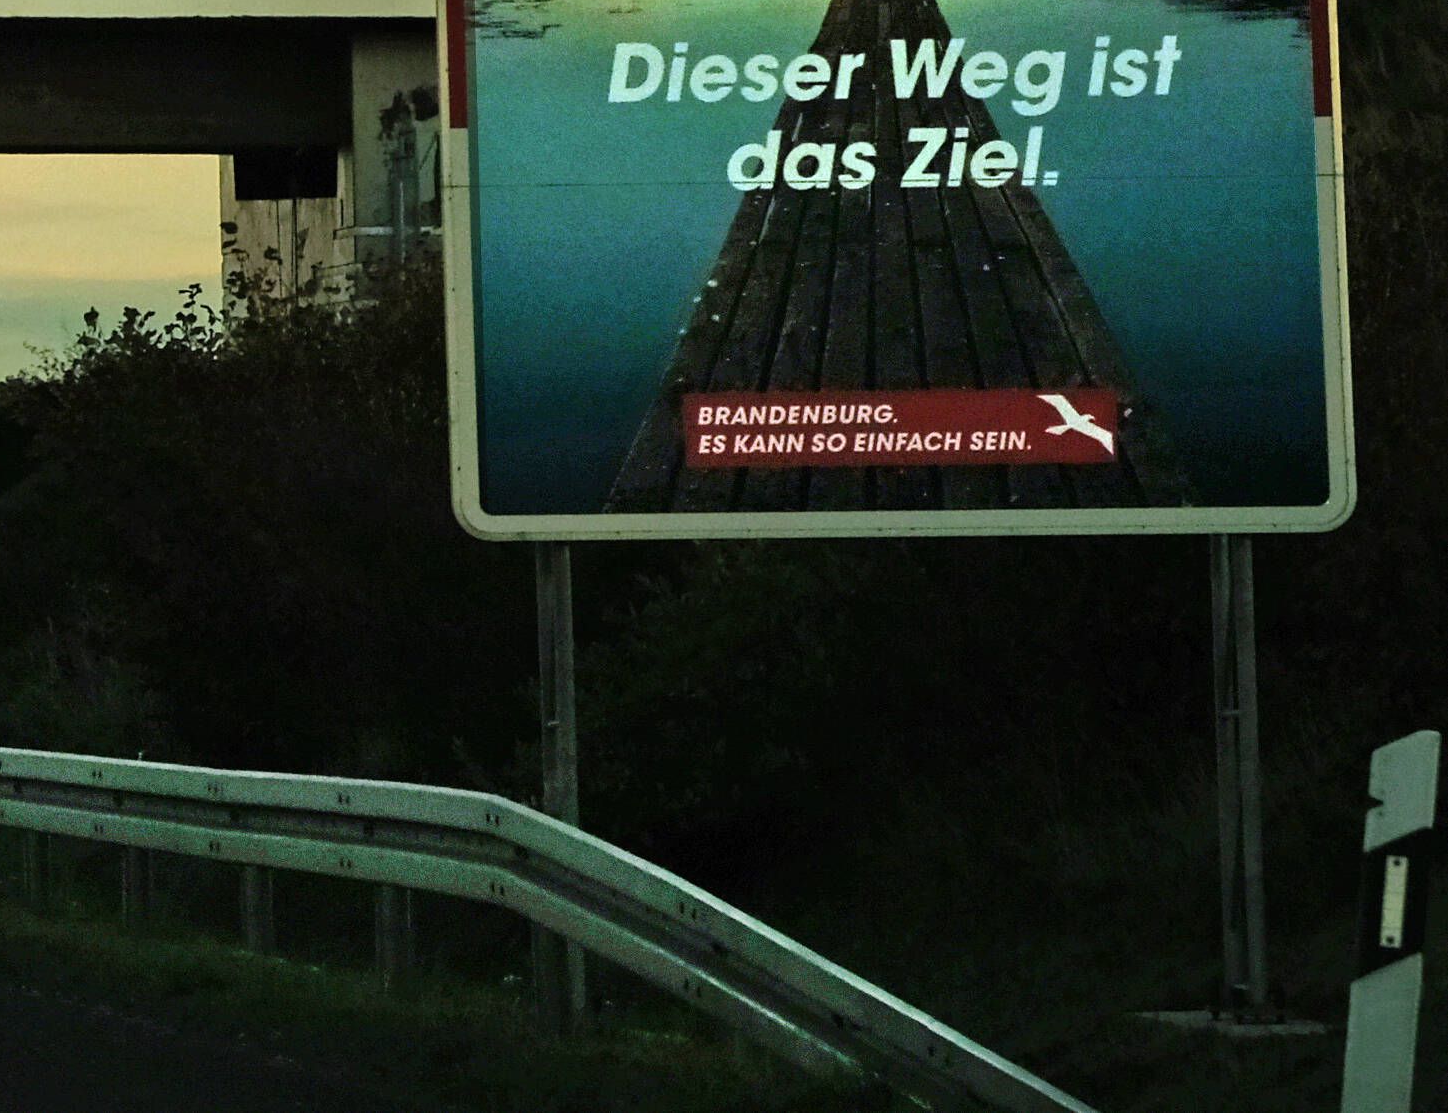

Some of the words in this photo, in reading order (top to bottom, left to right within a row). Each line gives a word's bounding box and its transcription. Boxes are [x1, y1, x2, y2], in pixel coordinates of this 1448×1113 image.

[607, 41, 866, 104] Dieser
[889, 37, 1067, 117] Weg
[1087, 35, 1183, 98] ist
[726, 129, 878, 191] das
[899, 126, 1060, 189] Ziel.
[697, 404, 898, 426] BRANDENBURG.
[698, 435, 727, 455] ES
[733, 434, 804, 454] KANN
[811, 433, 847, 454] SO
[853, 432, 961, 454] EINFACH
[969, 431, 1033, 452] SEIN.
